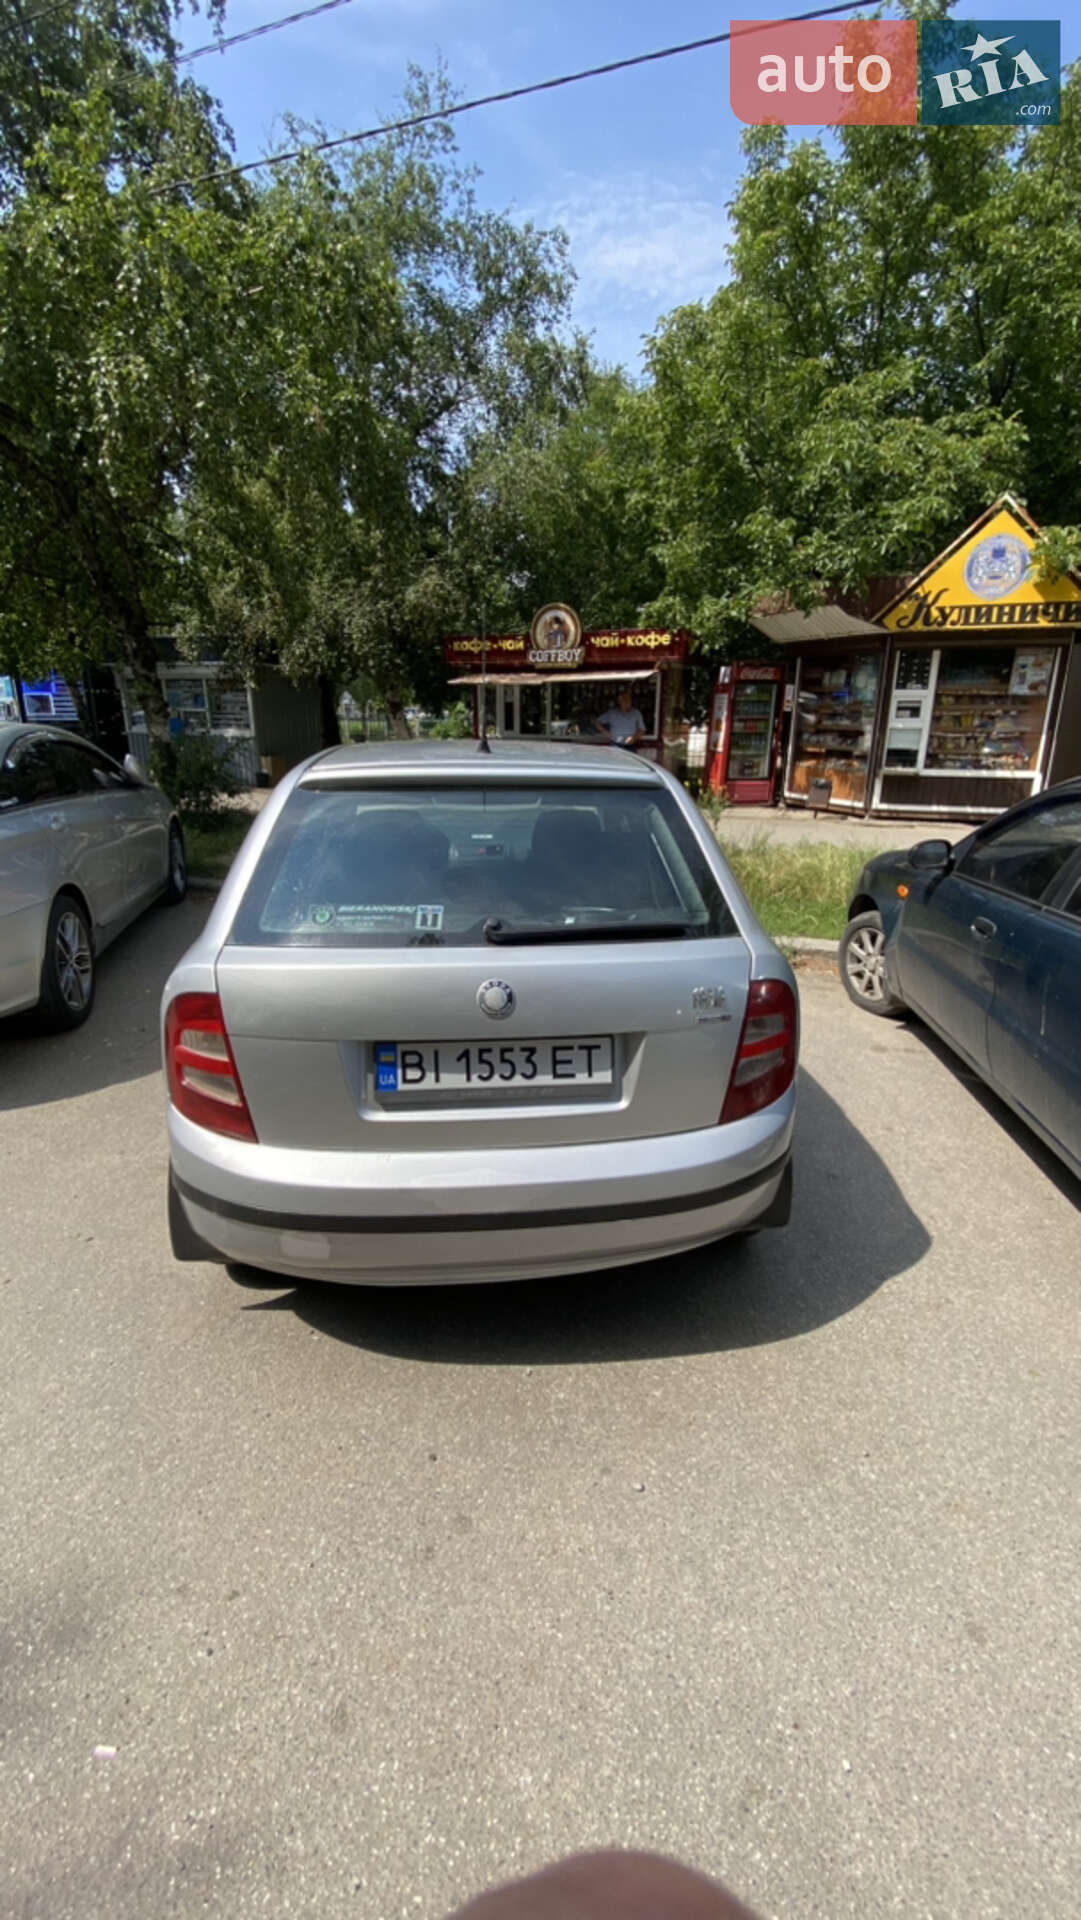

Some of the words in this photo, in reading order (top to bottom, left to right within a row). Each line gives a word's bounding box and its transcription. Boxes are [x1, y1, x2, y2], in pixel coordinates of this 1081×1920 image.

[456, 1047, 537, 1083] 1553
[552, 1045, 601, 1079] ET
[379, 1074, 395, 1085] UA
